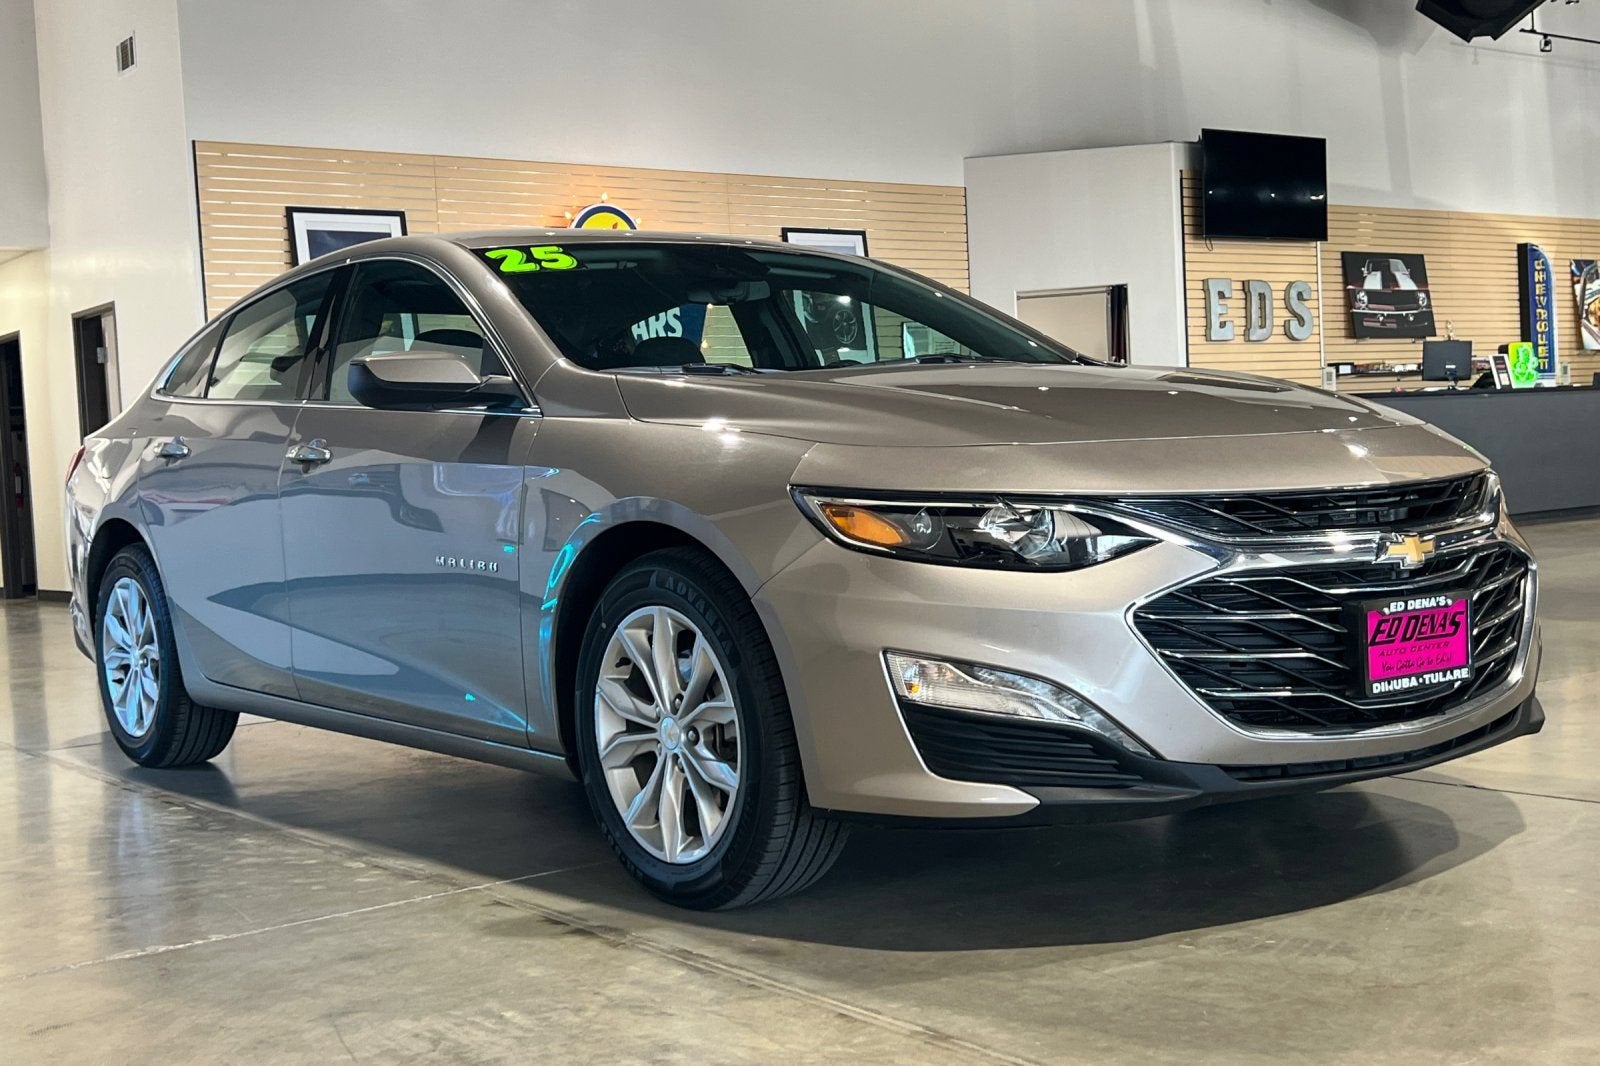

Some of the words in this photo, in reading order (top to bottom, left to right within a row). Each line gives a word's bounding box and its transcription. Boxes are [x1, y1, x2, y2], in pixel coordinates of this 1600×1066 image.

[485, 246, 577, 272] 25
[1534, 258, 1549, 370] CHEVROLET
[435, 556, 499, 573] MALIBU
[1390, 601, 1405, 613] ED
[1407, 596, 1447, 610] DENA'S
[1368, 616, 1404, 647] ED
[1400, 611, 1464, 643] DENA'S
[1378, 647, 1406, 657] AUTO
[1410, 641, 1450, 653] CENTER
[1423, 668, 1469, 685] TULARE
